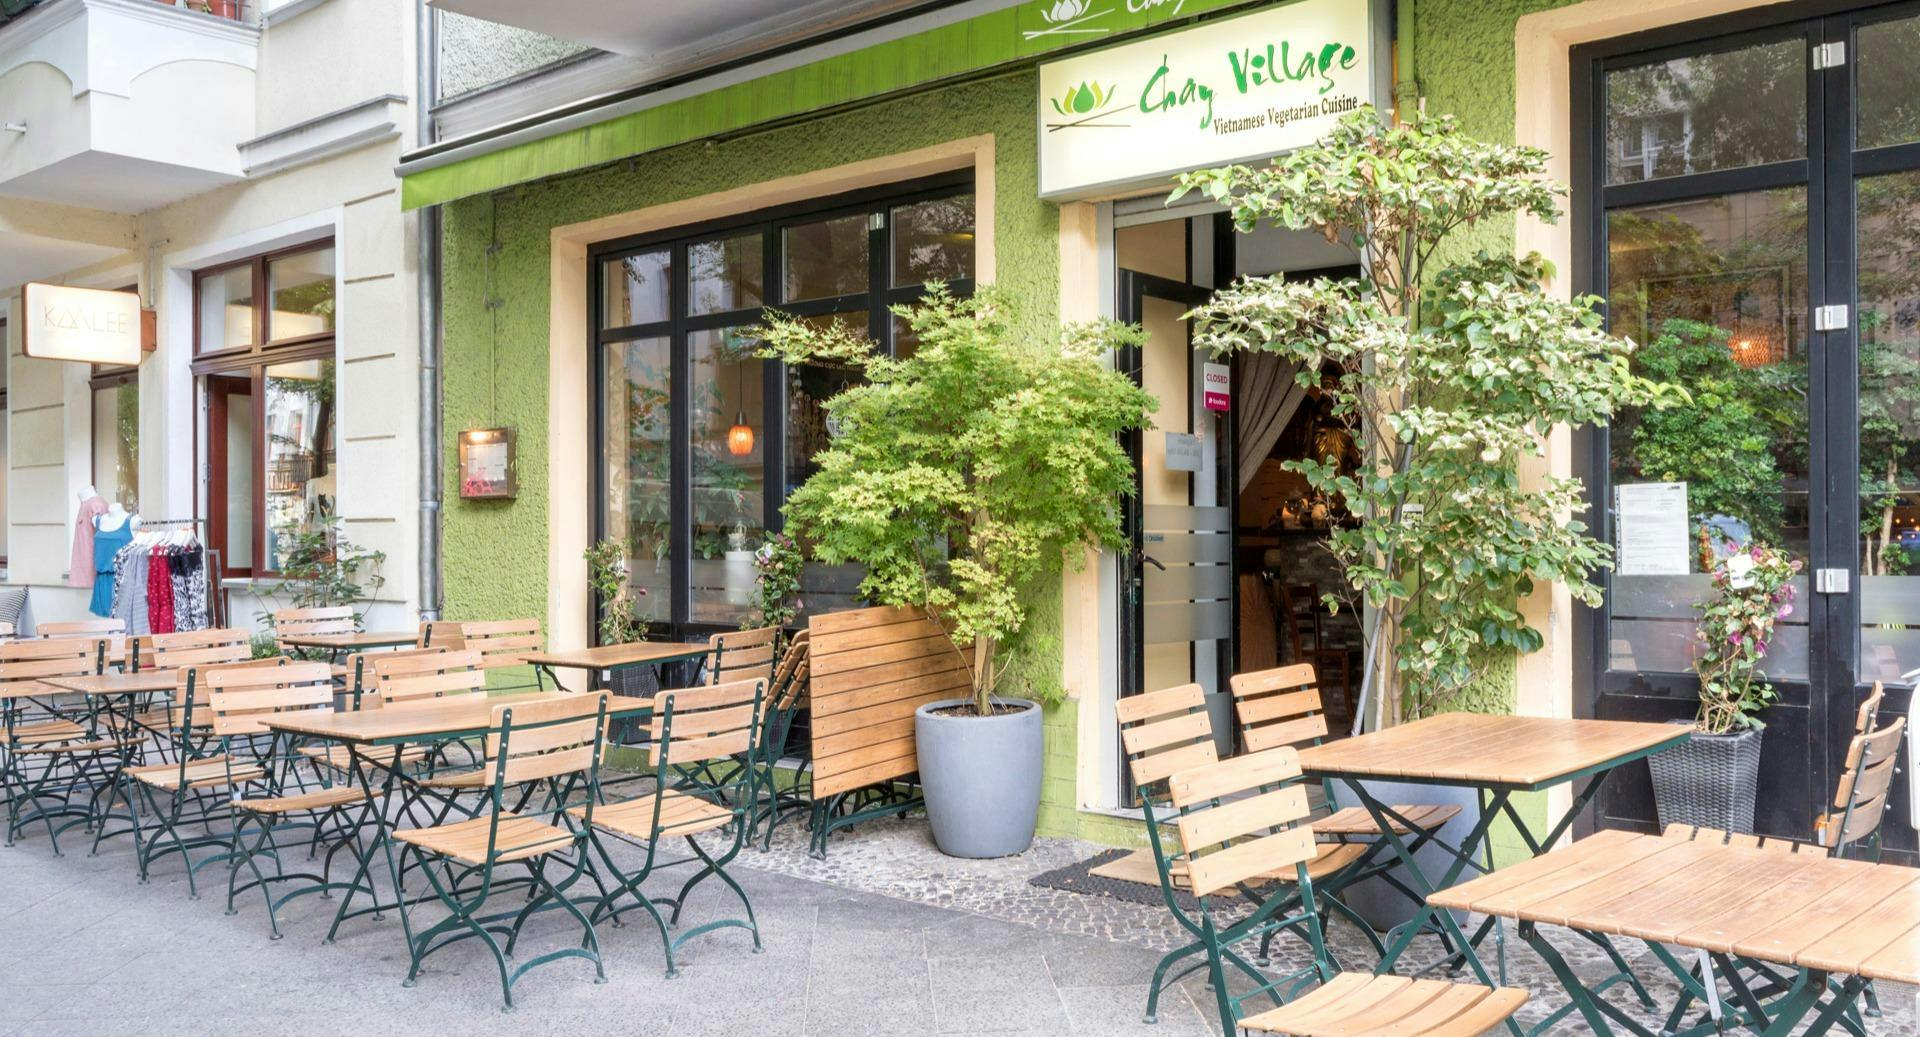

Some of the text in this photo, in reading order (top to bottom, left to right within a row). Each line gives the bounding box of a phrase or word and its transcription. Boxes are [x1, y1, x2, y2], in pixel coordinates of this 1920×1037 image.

[1139, 41, 1359, 129] Chay Village
[1213, 94, 1358, 135] Vietnamese Vegetarian Cuisine
[1206, 373, 1228, 384] CLOSED
